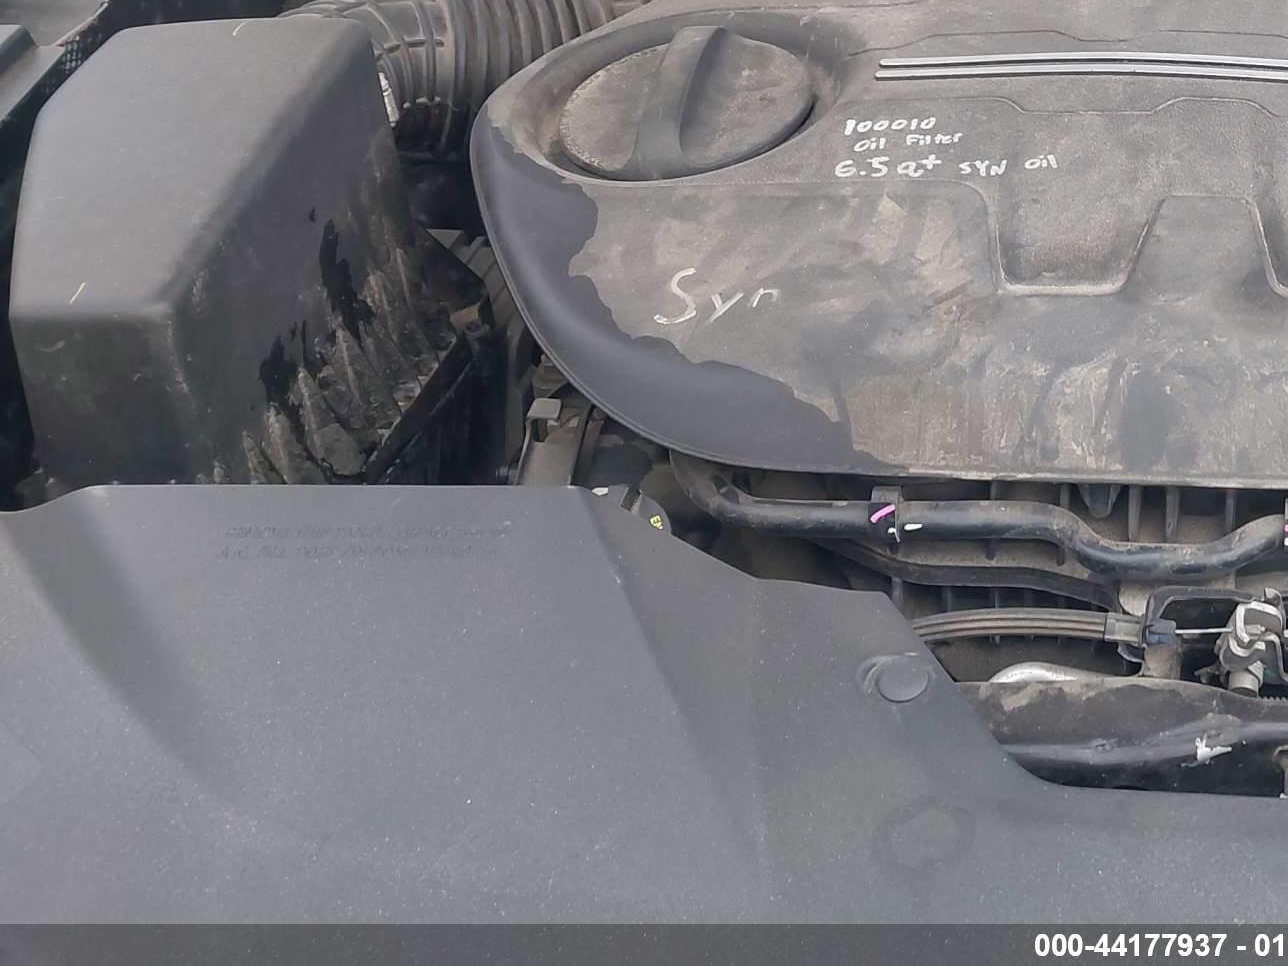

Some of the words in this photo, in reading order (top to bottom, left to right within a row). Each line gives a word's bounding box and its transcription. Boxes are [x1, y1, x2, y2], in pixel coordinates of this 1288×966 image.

[844, 117, 937, 136] 100010
[905, 133, 964, 146] Filter
[834, 156, 890, 178] 6.5
[958, 159, 1008, 177] SYN
